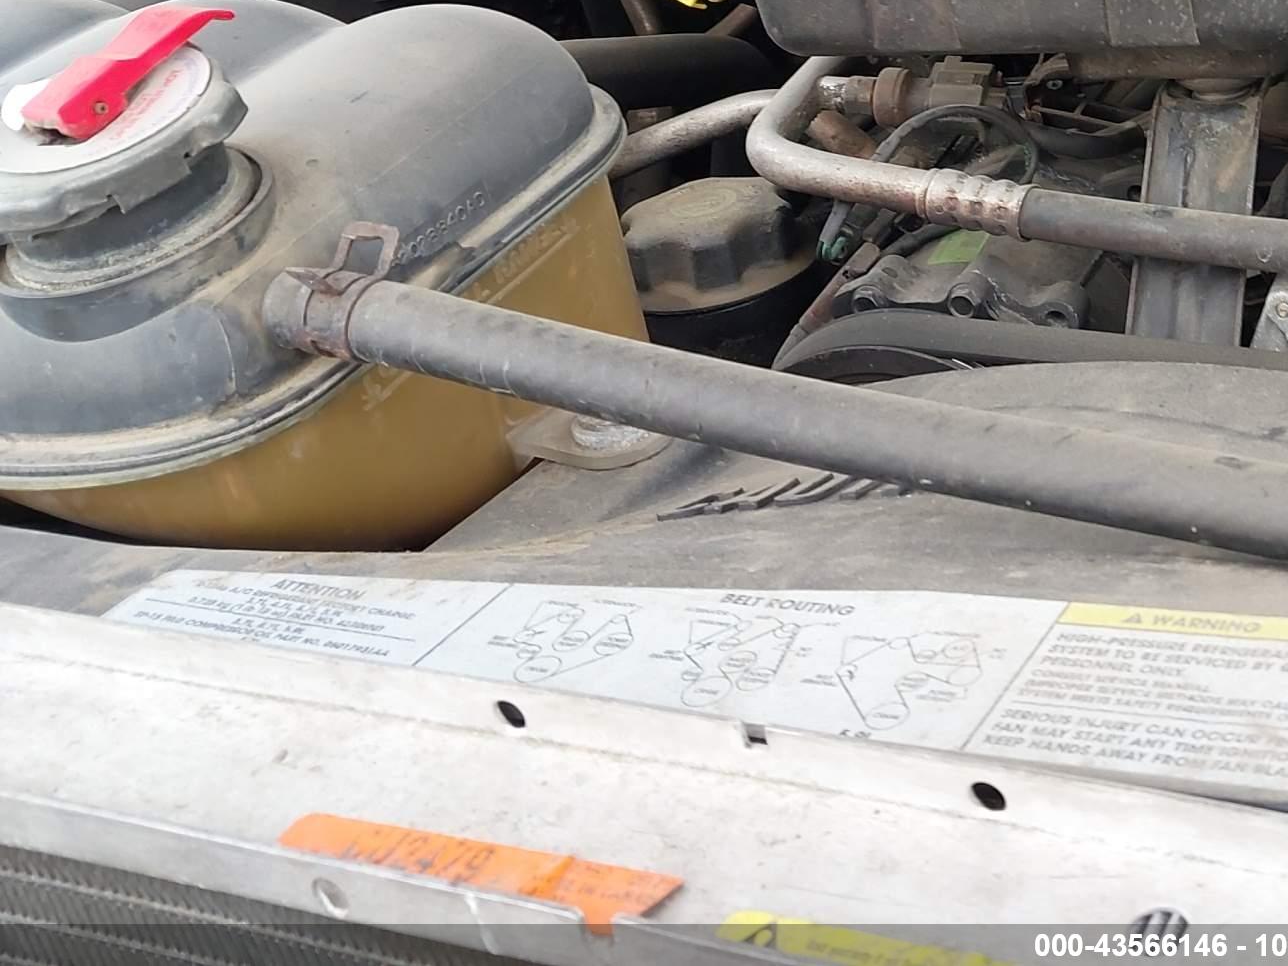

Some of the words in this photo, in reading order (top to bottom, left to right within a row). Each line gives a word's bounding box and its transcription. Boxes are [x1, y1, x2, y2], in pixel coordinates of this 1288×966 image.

[271, 579, 367, 601] ATTENTION
[720, 593, 766, 608] BELT
[767, 598, 857, 617] ROUTING
[1152, 614, 1262, 634] WARNING
[1056, 633, 1187, 652] HIGH-PRESSURE
[1040, 655, 1134, 673] PERSONNEL
[1048, 644, 1110, 658] SYSTEM
[1115, 648, 1136, 660] TO
[1141, 652, 1162, 662] BE
[1164, 654, 1248, 670] SERVICED
[1251, 661, 1275, 671] BY
[992, 721, 1027, 734] FAN
[1031, 726, 1072, 739] MAY
[1072, 730, 1128, 744] START
[1129, 737, 1170, 750] ANY
[1172, 742, 1214, 756] TIME
[1000, 708, 1074, 725] SERIOUS
[1077, 717, 1143, 734] INJURY
[1146, 723, 1188, 739] CAN
[1190, 729, 1259, 745] OCCUR
[984, 734, 1026, 747] KEEP
[1028, 740, 1093, 755] HANDS
[1096, 747, 1148, 761] AWAY
[1151, 752, 1211, 768] FROM
[1212, 759, 1250, 773] FAN
